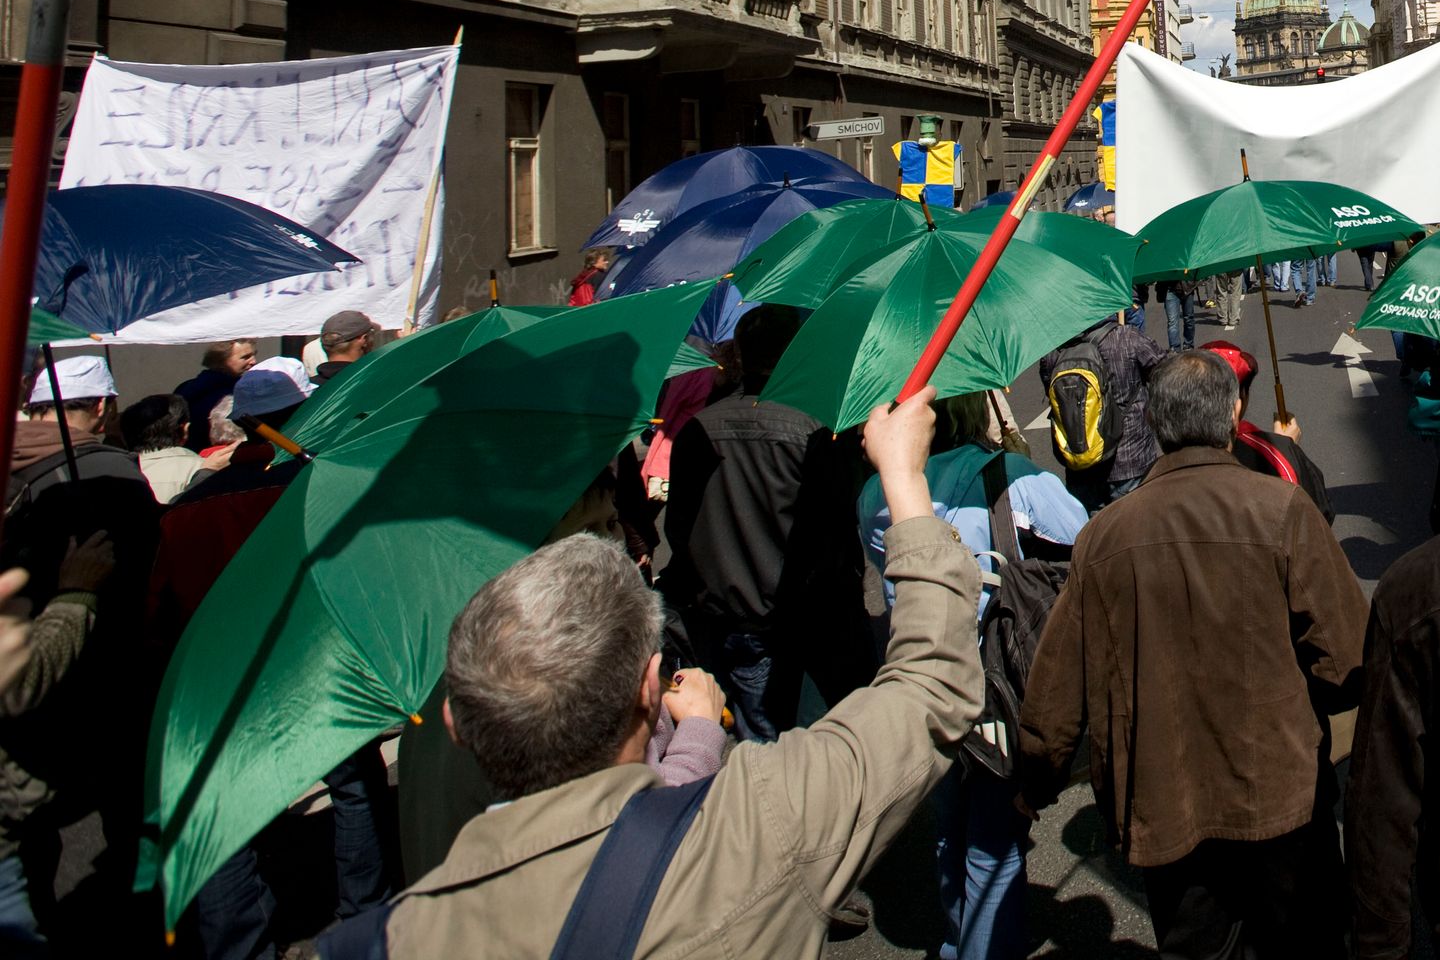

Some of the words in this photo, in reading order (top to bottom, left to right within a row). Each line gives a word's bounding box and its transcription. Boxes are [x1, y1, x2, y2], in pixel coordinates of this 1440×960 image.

[838, 122, 880, 134] SMÍCHOV
[1330, 205, 1371, 218] ASO
[1380, 303, 1429, 319] OSPZV-ASO
